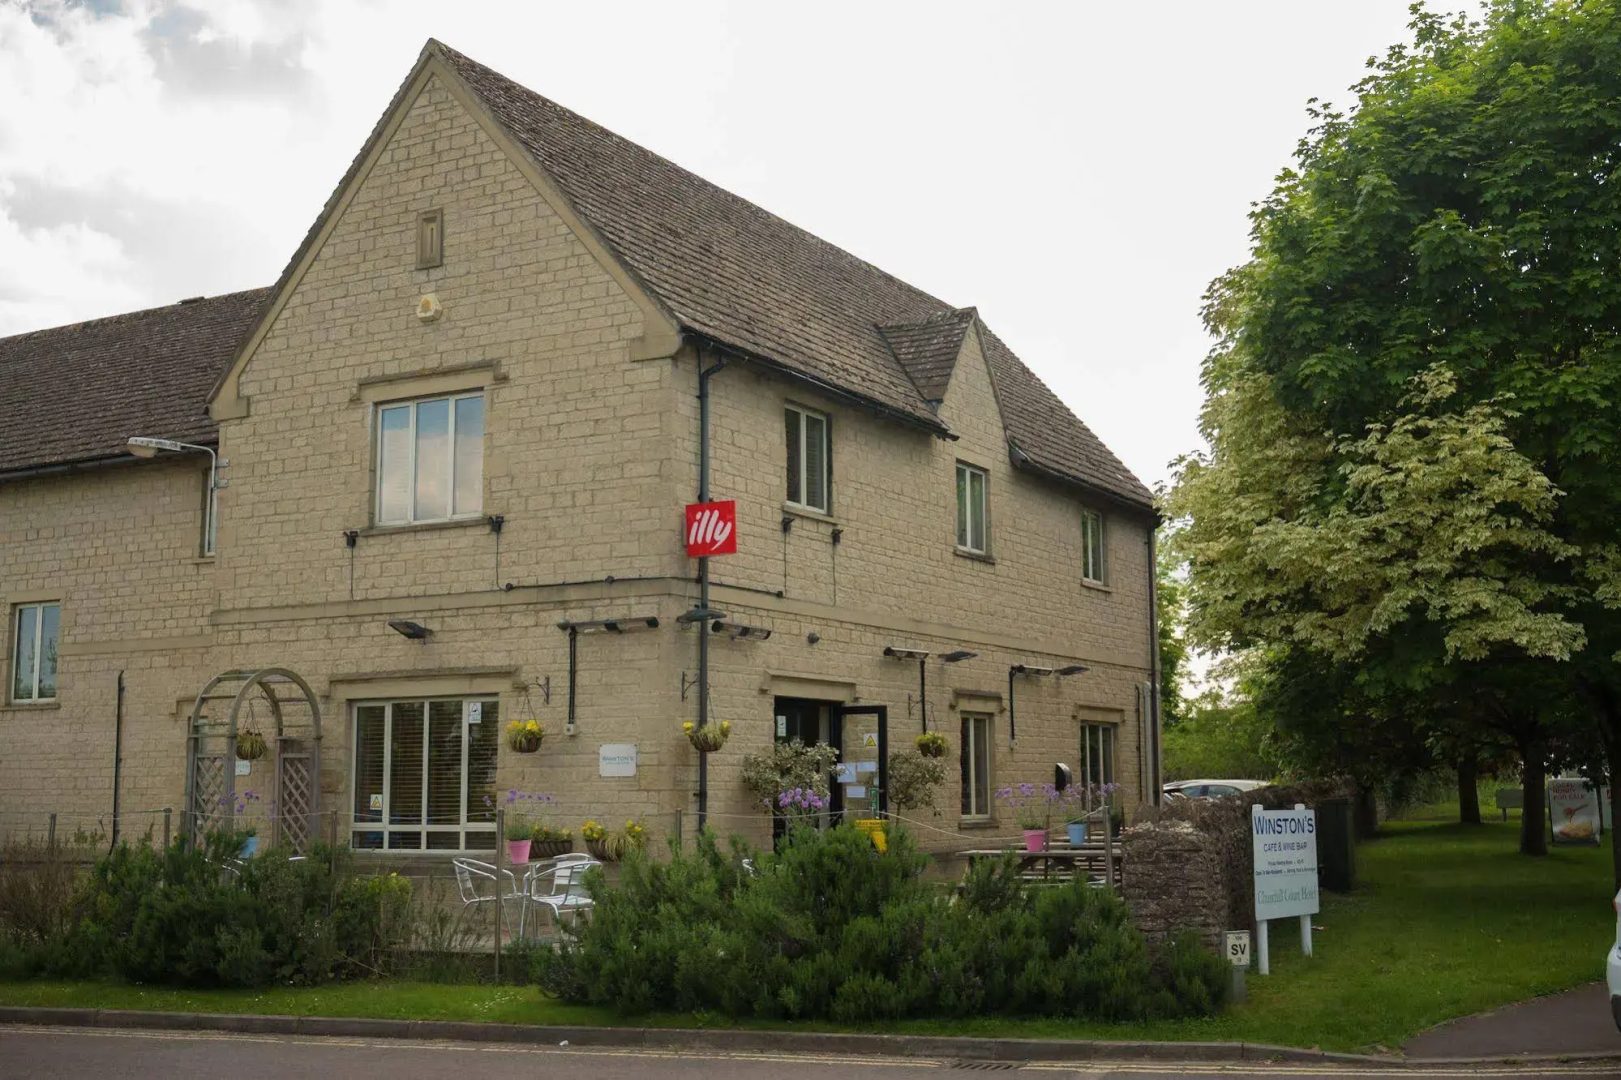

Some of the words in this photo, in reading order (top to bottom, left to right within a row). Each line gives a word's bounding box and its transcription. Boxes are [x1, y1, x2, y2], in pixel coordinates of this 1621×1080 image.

[689, 509, 733, 551] illy
[1254, 815, 1314, 835] WINSTON'S
[1278, 841, 1282, 851] &
[1297, 841, 1307, 850] BAR
[1231, 943, 1246, 956] SV
